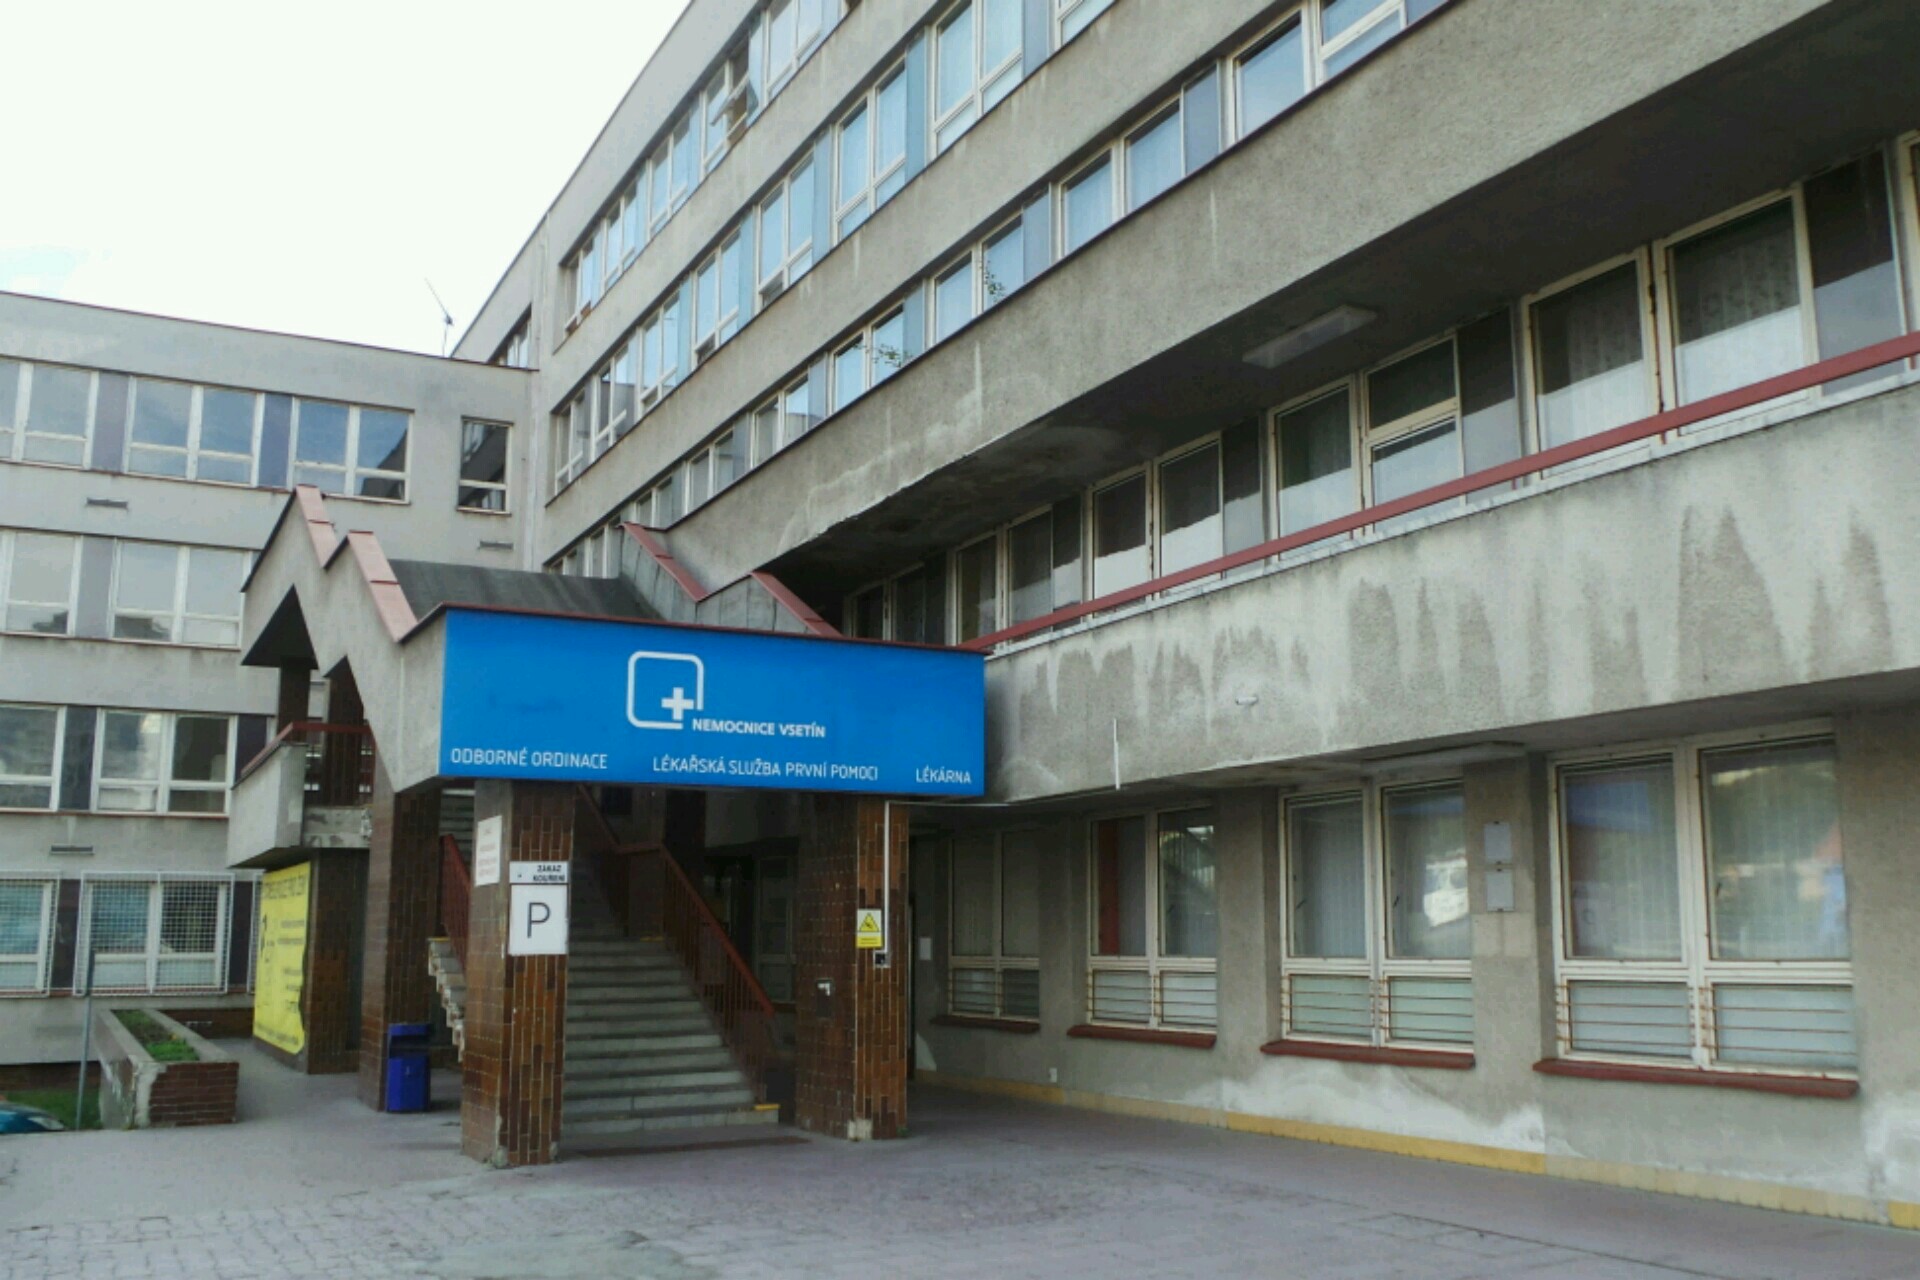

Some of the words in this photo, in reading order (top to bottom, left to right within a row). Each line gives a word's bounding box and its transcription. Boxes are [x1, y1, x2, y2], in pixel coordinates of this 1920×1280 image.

[692, 718, 775, 736] NEMOCNICE
[779, 721, 826, 738] VSETÍN
[451, 747, 528, 767] ODBORNÉ
[531, 751, 608, 769] ORDINACE
[653, 754, 725, 774] LÉKAŘSKÁ
[728, 757, 781, 776] SLUŽBA
[785, 761, 827, 779] PRVNÍ
[831, 763, 878, 781] POMOCI
[916, 764, 972, 785] LÉKÁRNA
[527, 901, 551, 939] P
